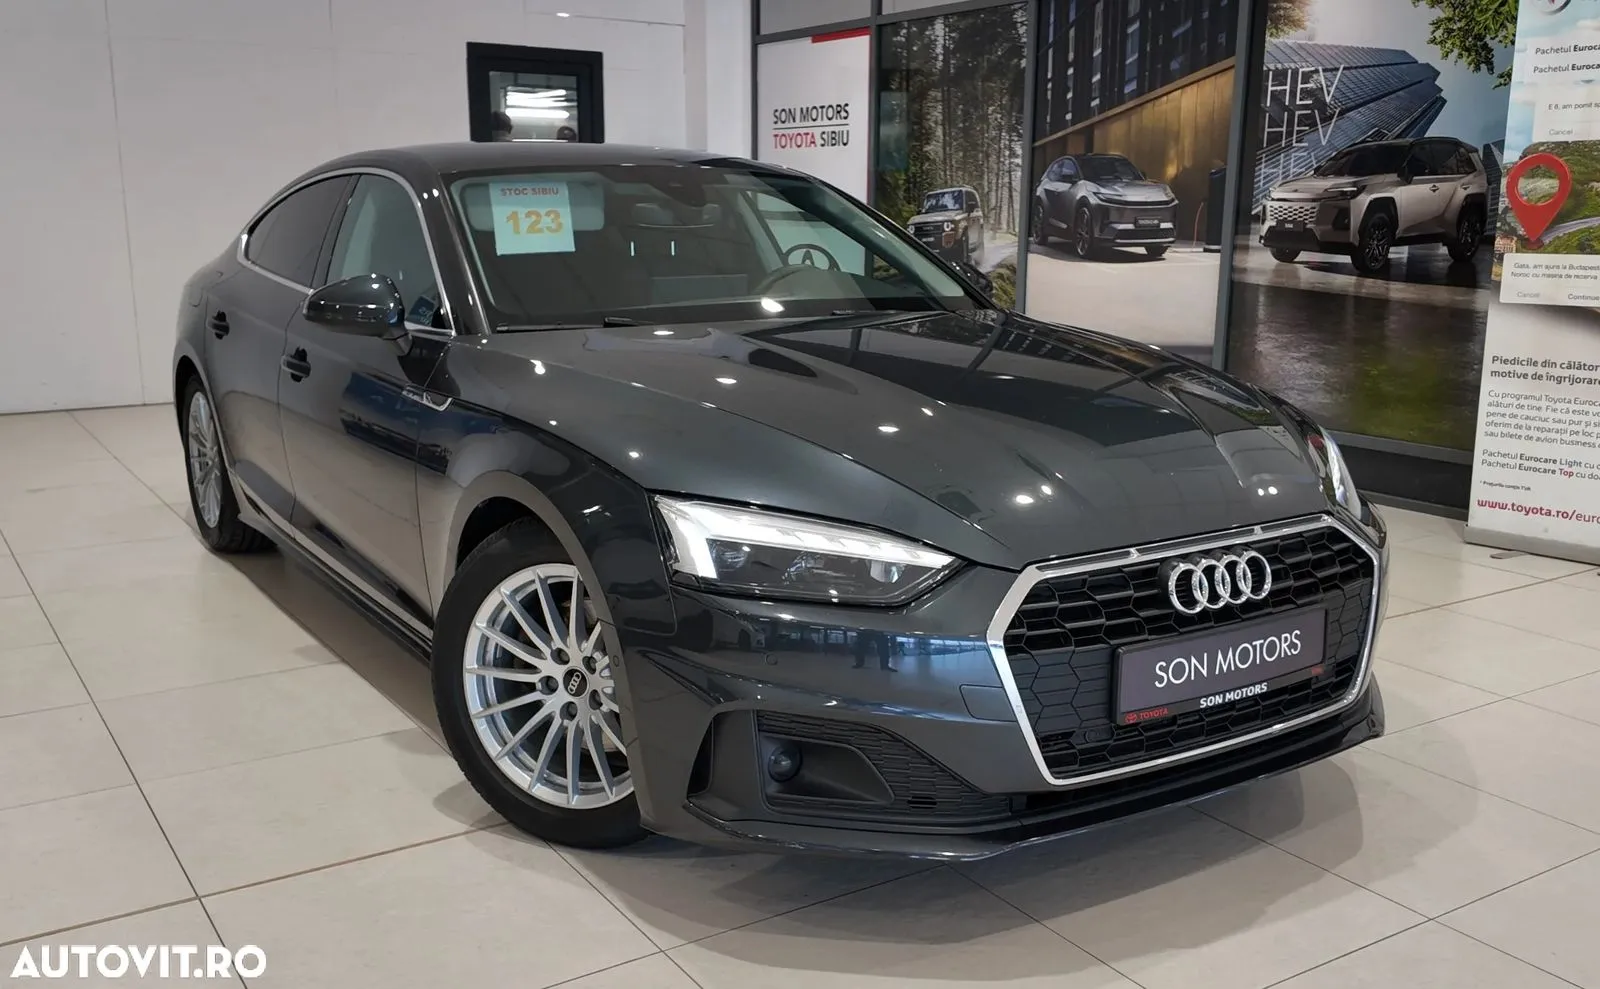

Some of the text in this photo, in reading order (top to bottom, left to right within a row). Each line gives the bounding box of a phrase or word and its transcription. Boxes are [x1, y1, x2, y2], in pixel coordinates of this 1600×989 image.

[1535, 46, 1571, 55] Pachetul
[1533, 64, 1569, 74] Pachetul
[1266, 64, 1344, 107] HEV
[773, 103, 849, 124] SON MOTORS
[1263, 108, 1341, 147] HEV
[773, 130, 850, 149] TOYOTA SIBIU
[500, 187, 559, 196] STOC SIBIU
[506, 209, 564, 235] 123
[1567, 293, 1600, 301] Continue
[1491, 355, 1539, 367] Piedicile
[1540, 359, 1557, 369] din
[1490, 370, 1529, 379] motive
[1530, 371, 1544, 381] de
[1488, 389, 1500, 398] Cu
[1501, 392, 1542, 401] programul
[1544, 394, 1572, 404] Toyota
[1546, 405, 1559, 413] Fie
[1519, 414, 1550, 422] cauciuc
[1485, 420, 1512, 429] oferim
[1513, 422, 1524, 430] de
[1525, 423, 1532, 431] la
[1569, 429, 1580, 437] pe
[1581, 429, 1595, 438] loc
[1500, 431, 1523, 440] bilete
[1535, 436, 1558, 444] avion
[1559, 438, 1596, 448] business
[1482, 449, 1518, 460] Pachetul
[1519, 453, 1558, 464] Eurocare
[1559, 458, 1582, 468] Light
[1481, 459, 1517, 469] Pachetul
[1518, 463, 1557, 475] Eurocare
[1559, 467, 1574, 478] Top
[1154, 630, 1301, 688] SON MOTORS
[1199, 682, 1268, 709] SON MOTORS
[1140, 708, 1168, 720] TOYOTA
